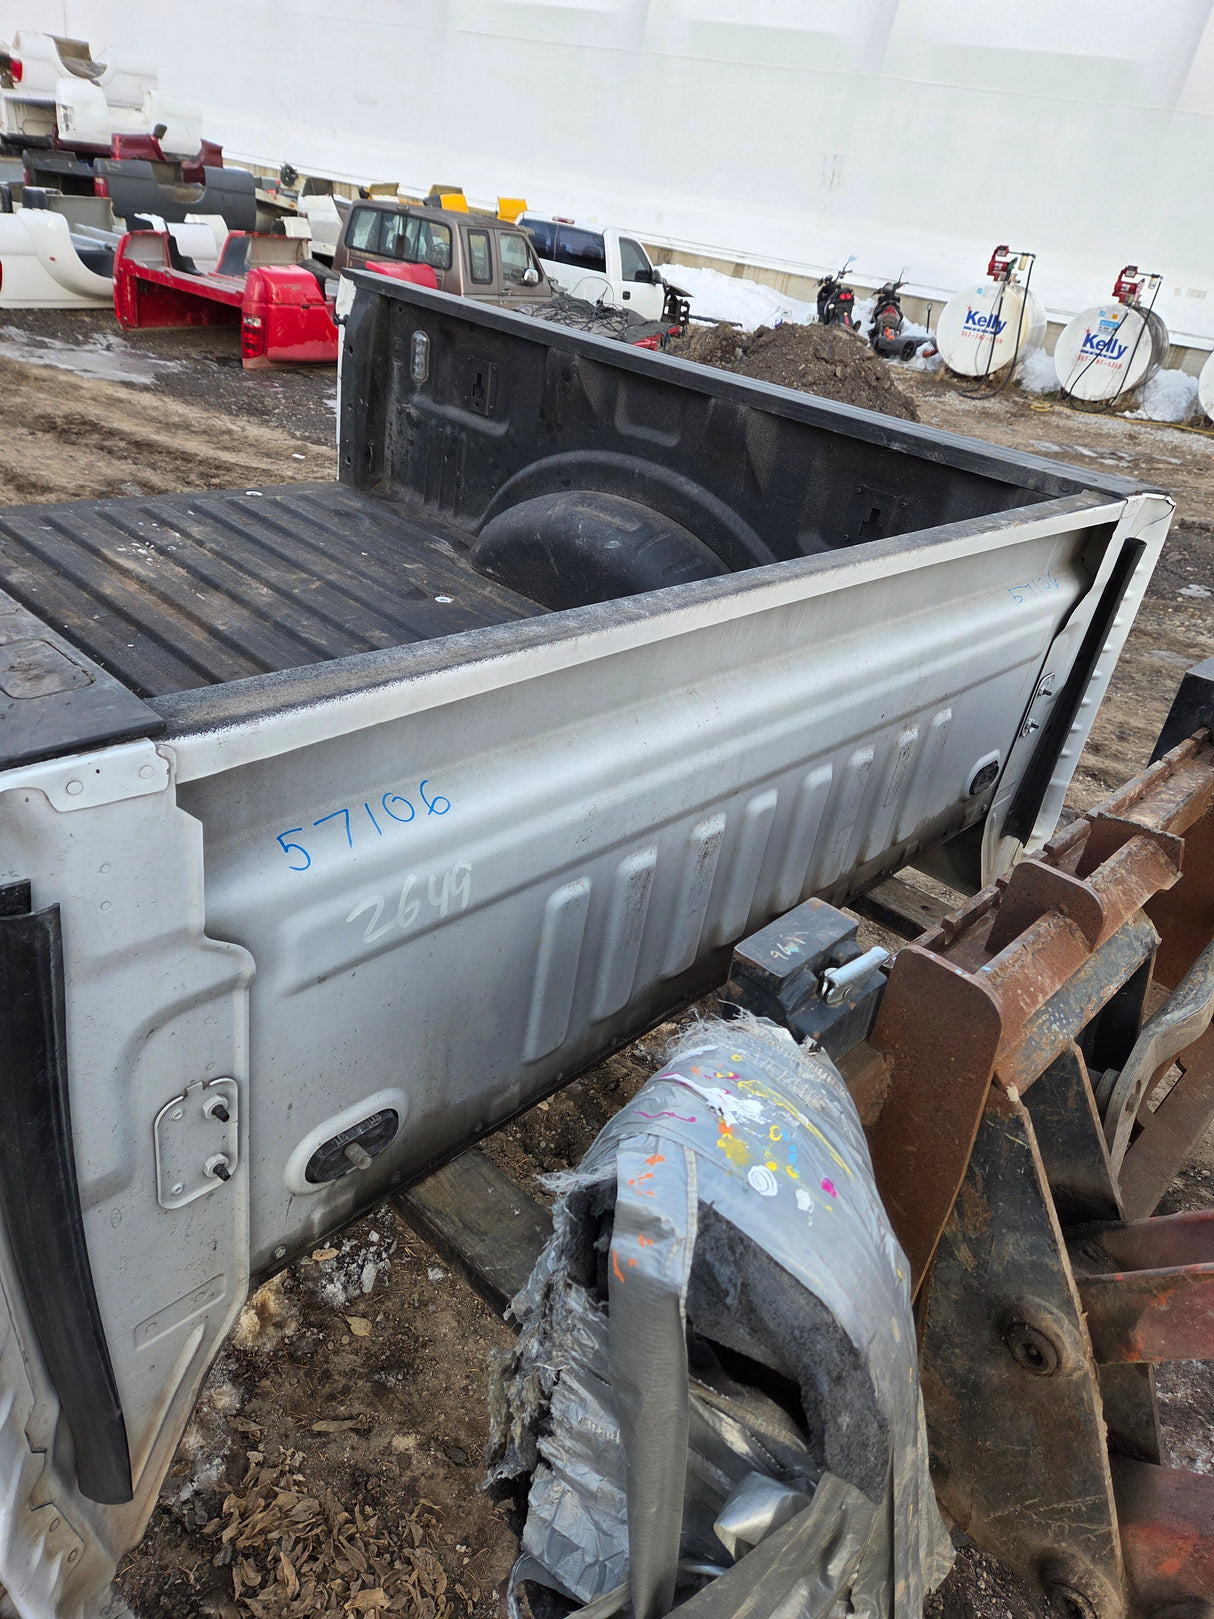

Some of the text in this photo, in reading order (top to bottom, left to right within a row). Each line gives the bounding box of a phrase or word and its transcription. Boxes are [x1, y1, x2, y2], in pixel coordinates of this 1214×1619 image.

[964, 310, 1008, 335] Kelly
[1082, 332, 1128, 360] Kelly
[276, 779, 451, 871] 57106
